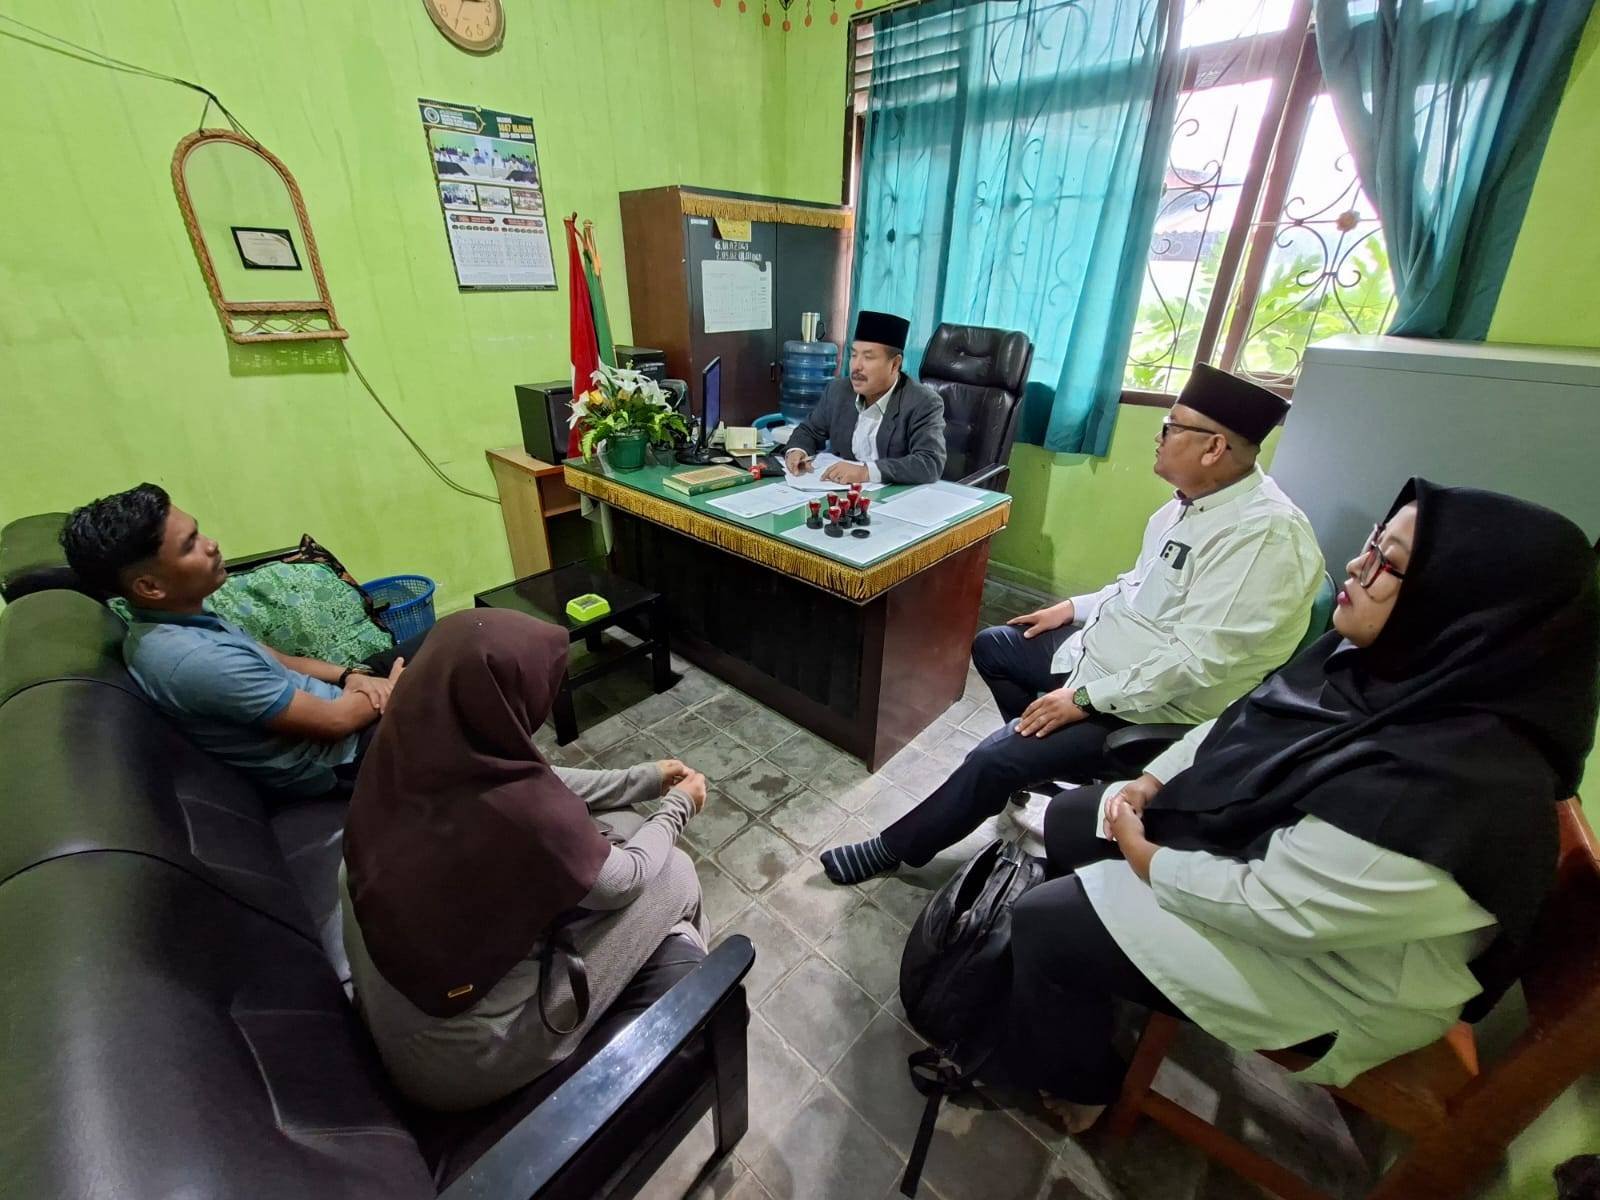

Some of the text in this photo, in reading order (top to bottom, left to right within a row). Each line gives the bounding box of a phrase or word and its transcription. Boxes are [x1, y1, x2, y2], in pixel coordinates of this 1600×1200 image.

[439, 4, 449, 17] 8
[484, 15, 490, 27] 4
[465, 25, 473, 38] 6
